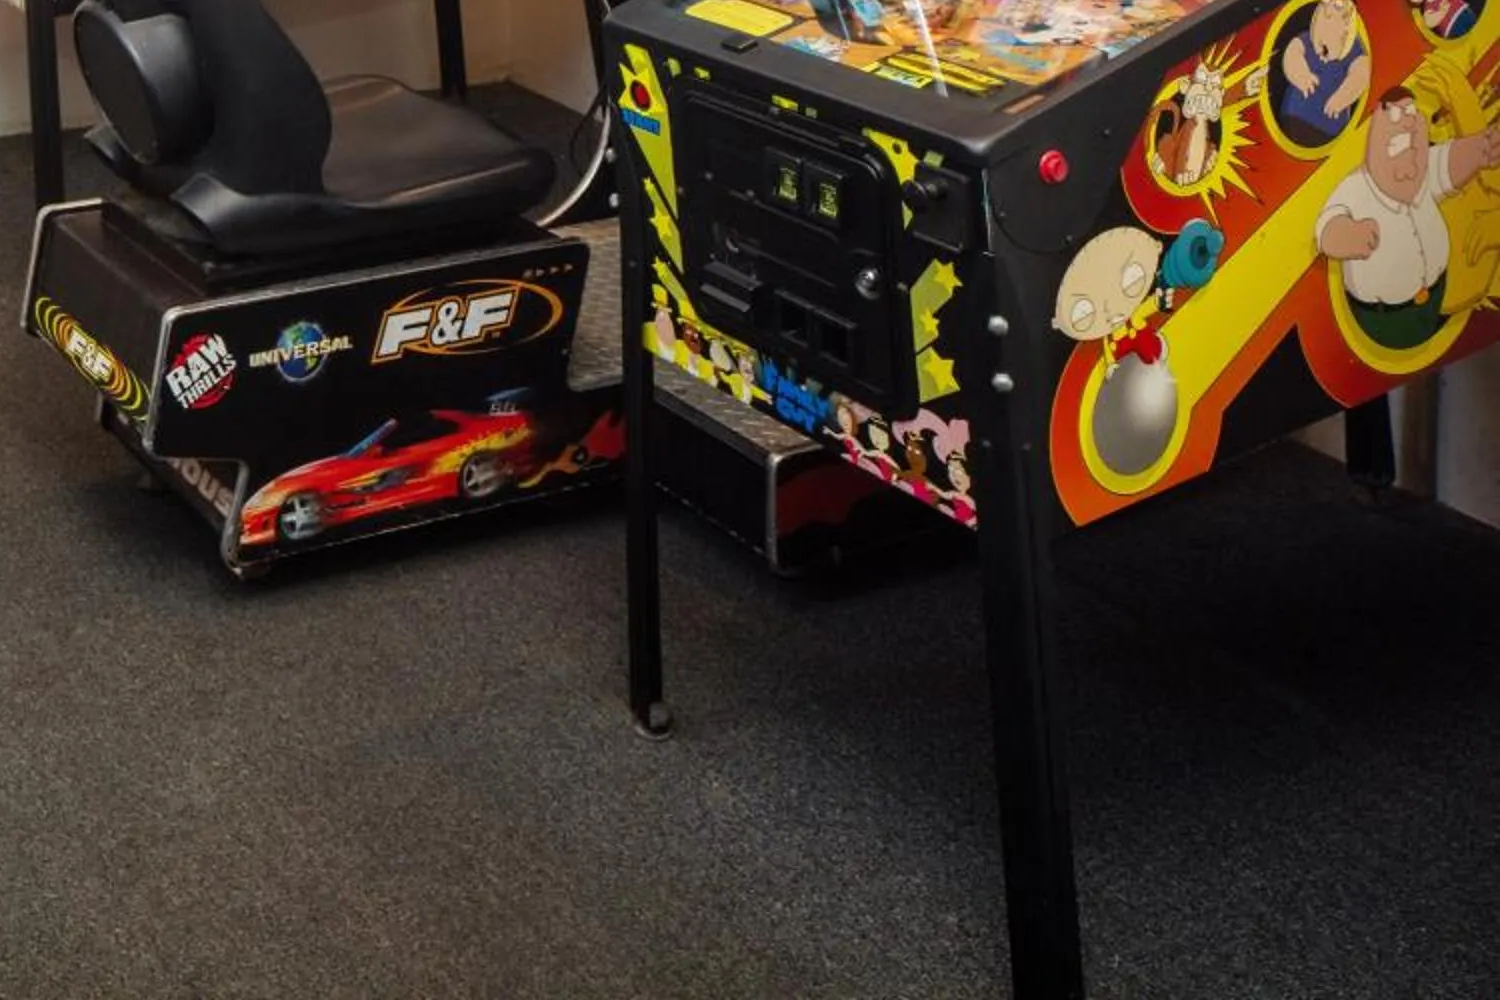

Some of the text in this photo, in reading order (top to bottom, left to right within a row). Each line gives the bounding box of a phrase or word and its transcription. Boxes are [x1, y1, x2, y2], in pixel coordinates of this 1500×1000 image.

[250, 335, 353, 367] UNIVERSAL
[377, 293, 514, 356] F&F
[66, 329, 115, 382] F&F
[166, 333, 228, 396] RAW
[177, 353, 237, 409] THRILLS
